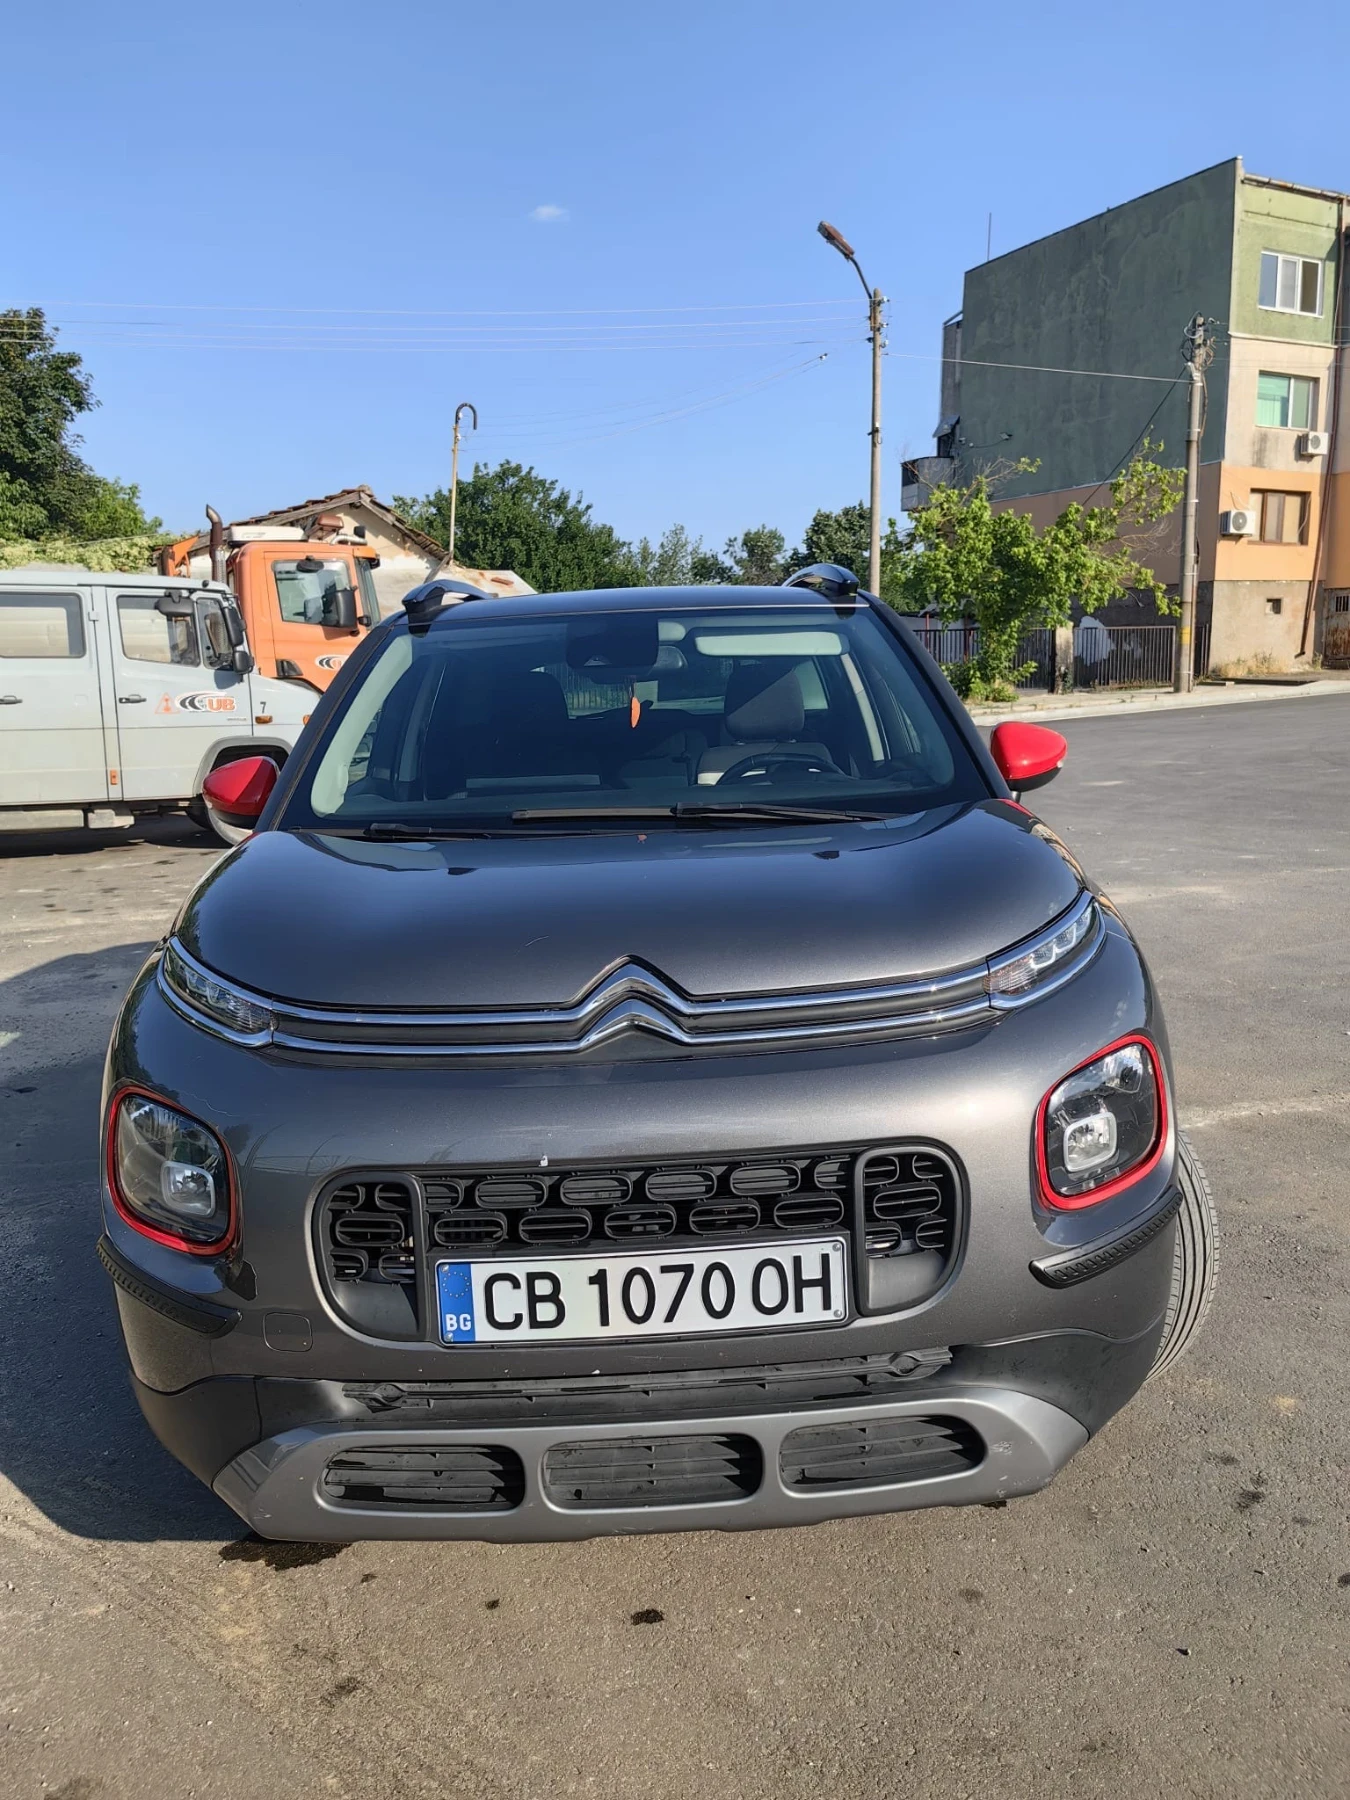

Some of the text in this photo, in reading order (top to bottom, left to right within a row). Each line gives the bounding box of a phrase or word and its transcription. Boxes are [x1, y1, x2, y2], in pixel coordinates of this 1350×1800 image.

[484, 1253, 832, 1331] CB 1070 OH
[445, 1313, 472, 1332] BG
